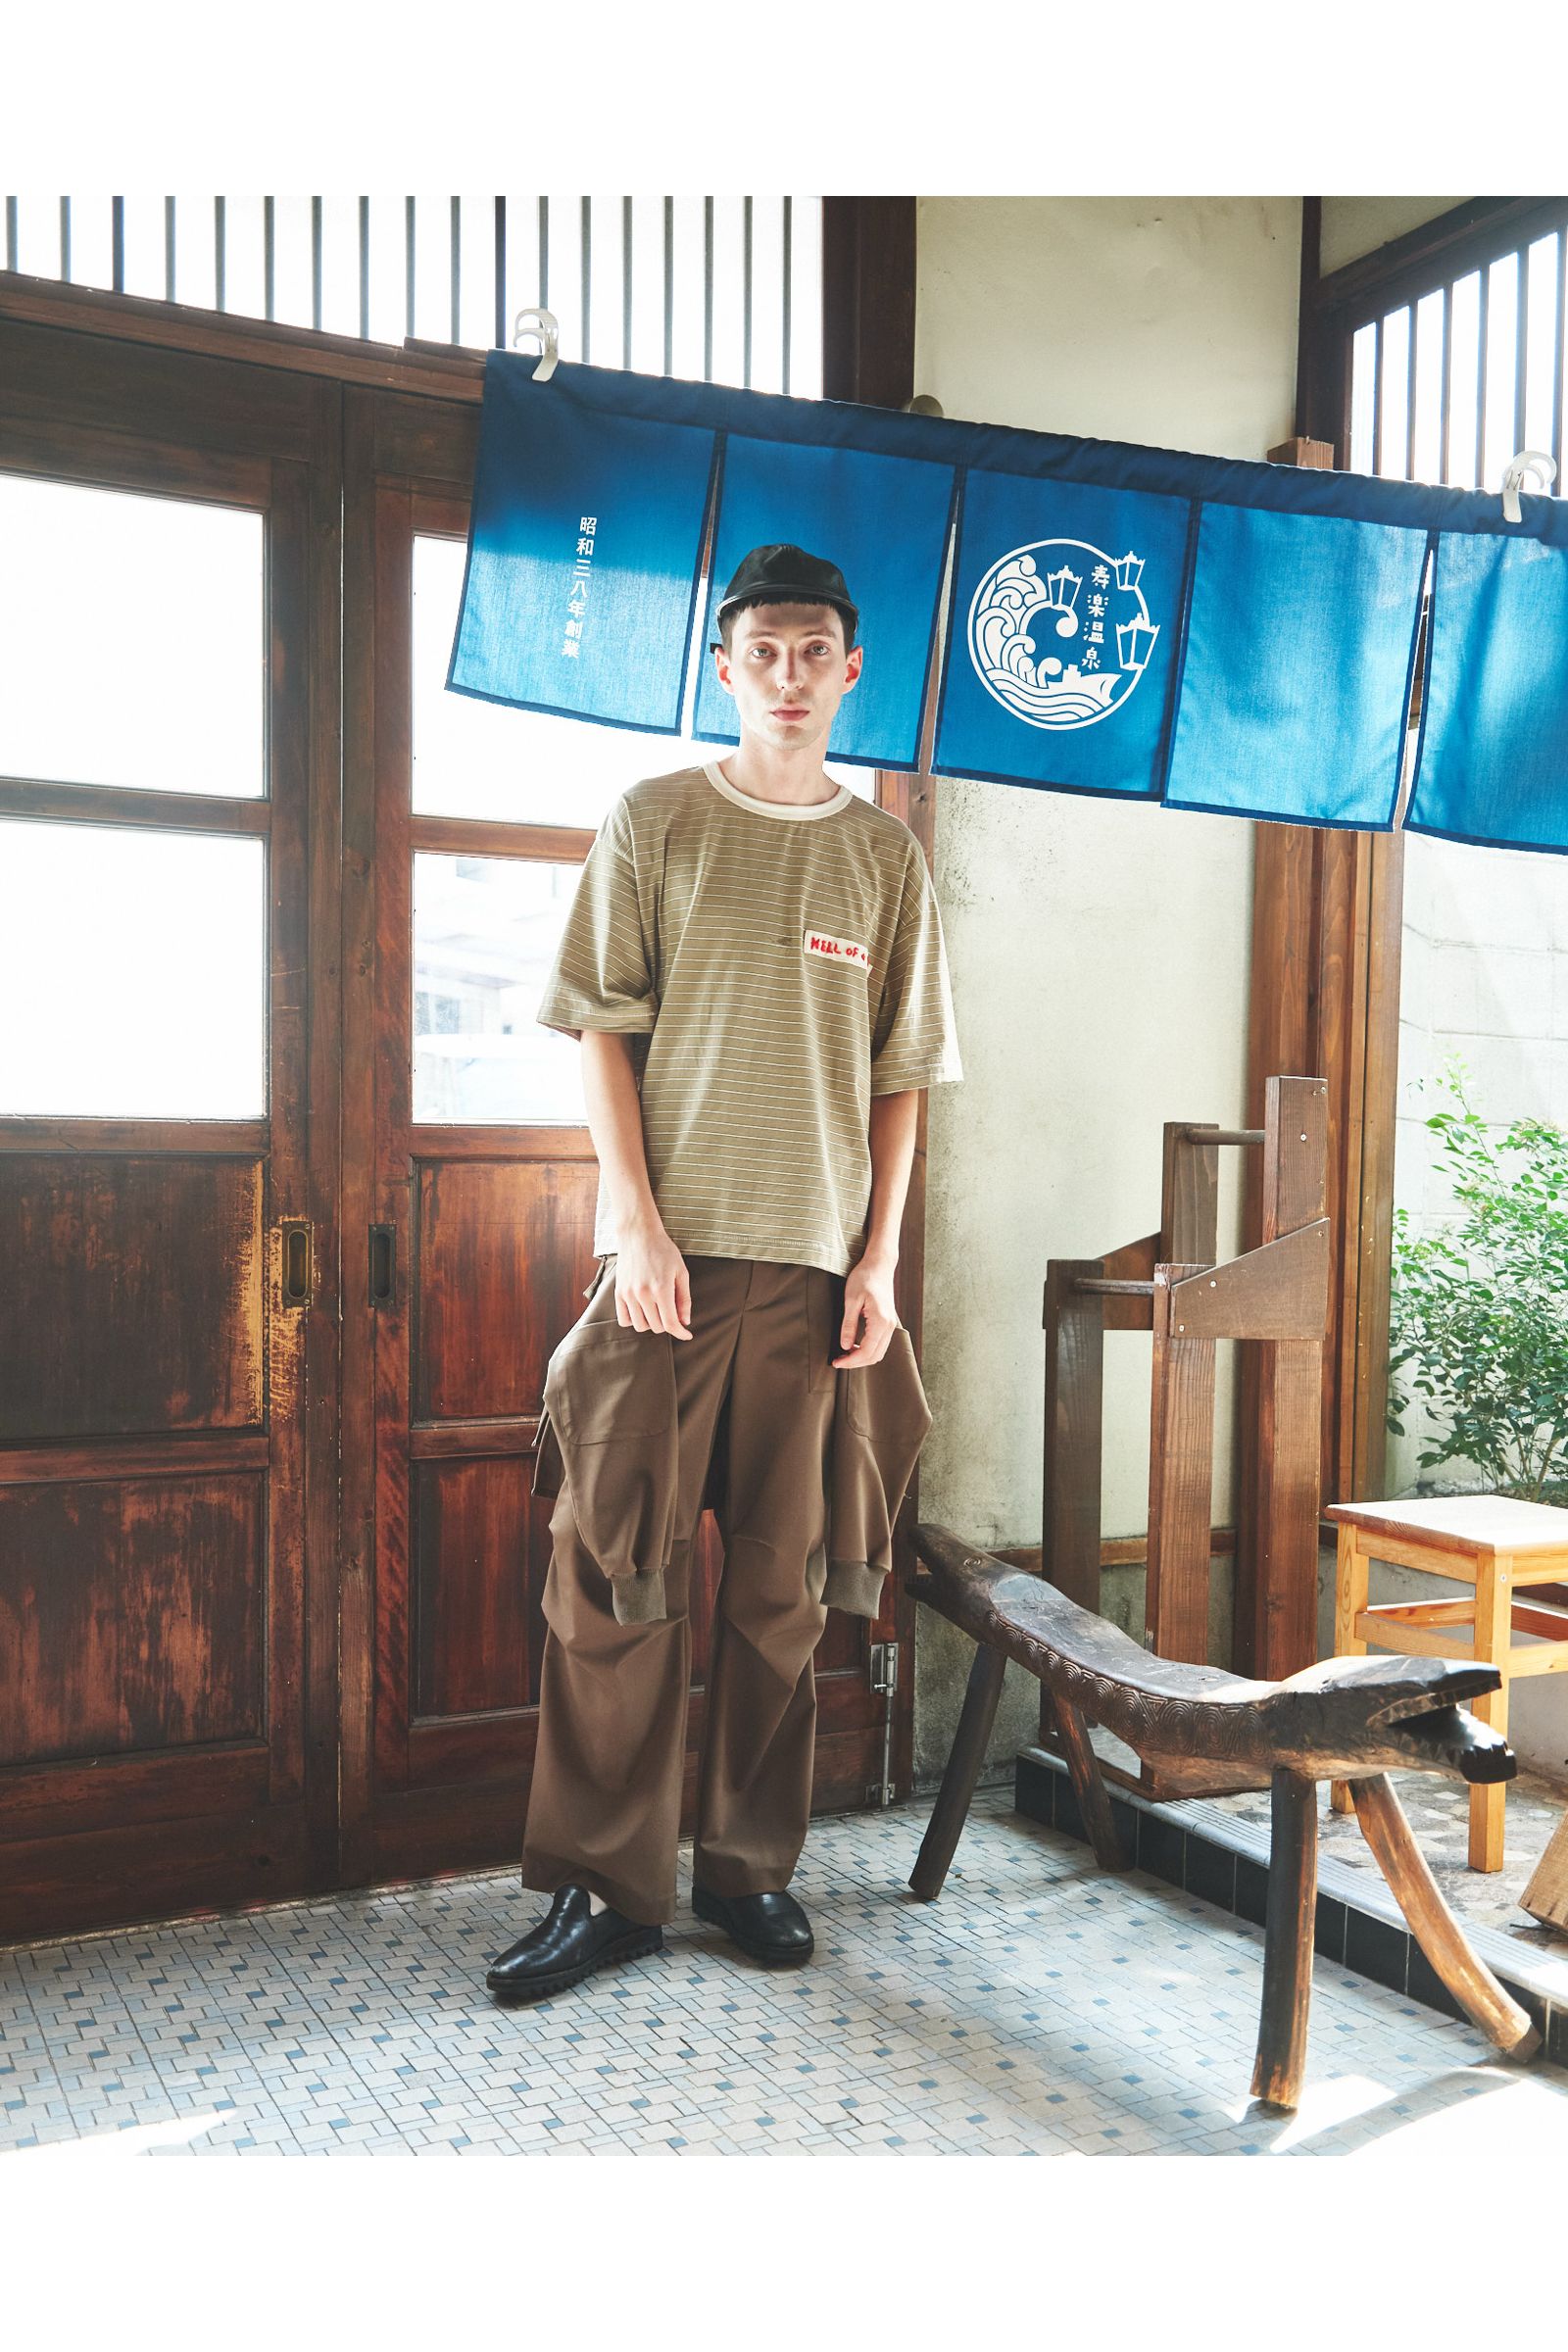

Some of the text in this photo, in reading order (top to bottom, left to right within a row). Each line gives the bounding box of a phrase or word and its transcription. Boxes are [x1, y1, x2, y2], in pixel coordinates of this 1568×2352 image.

[561, 516, 597, 659] 昭和三八年創業
[1081, 564, 1110, 669] 寿楽温泉
[846, 947, 859, 957] OF
